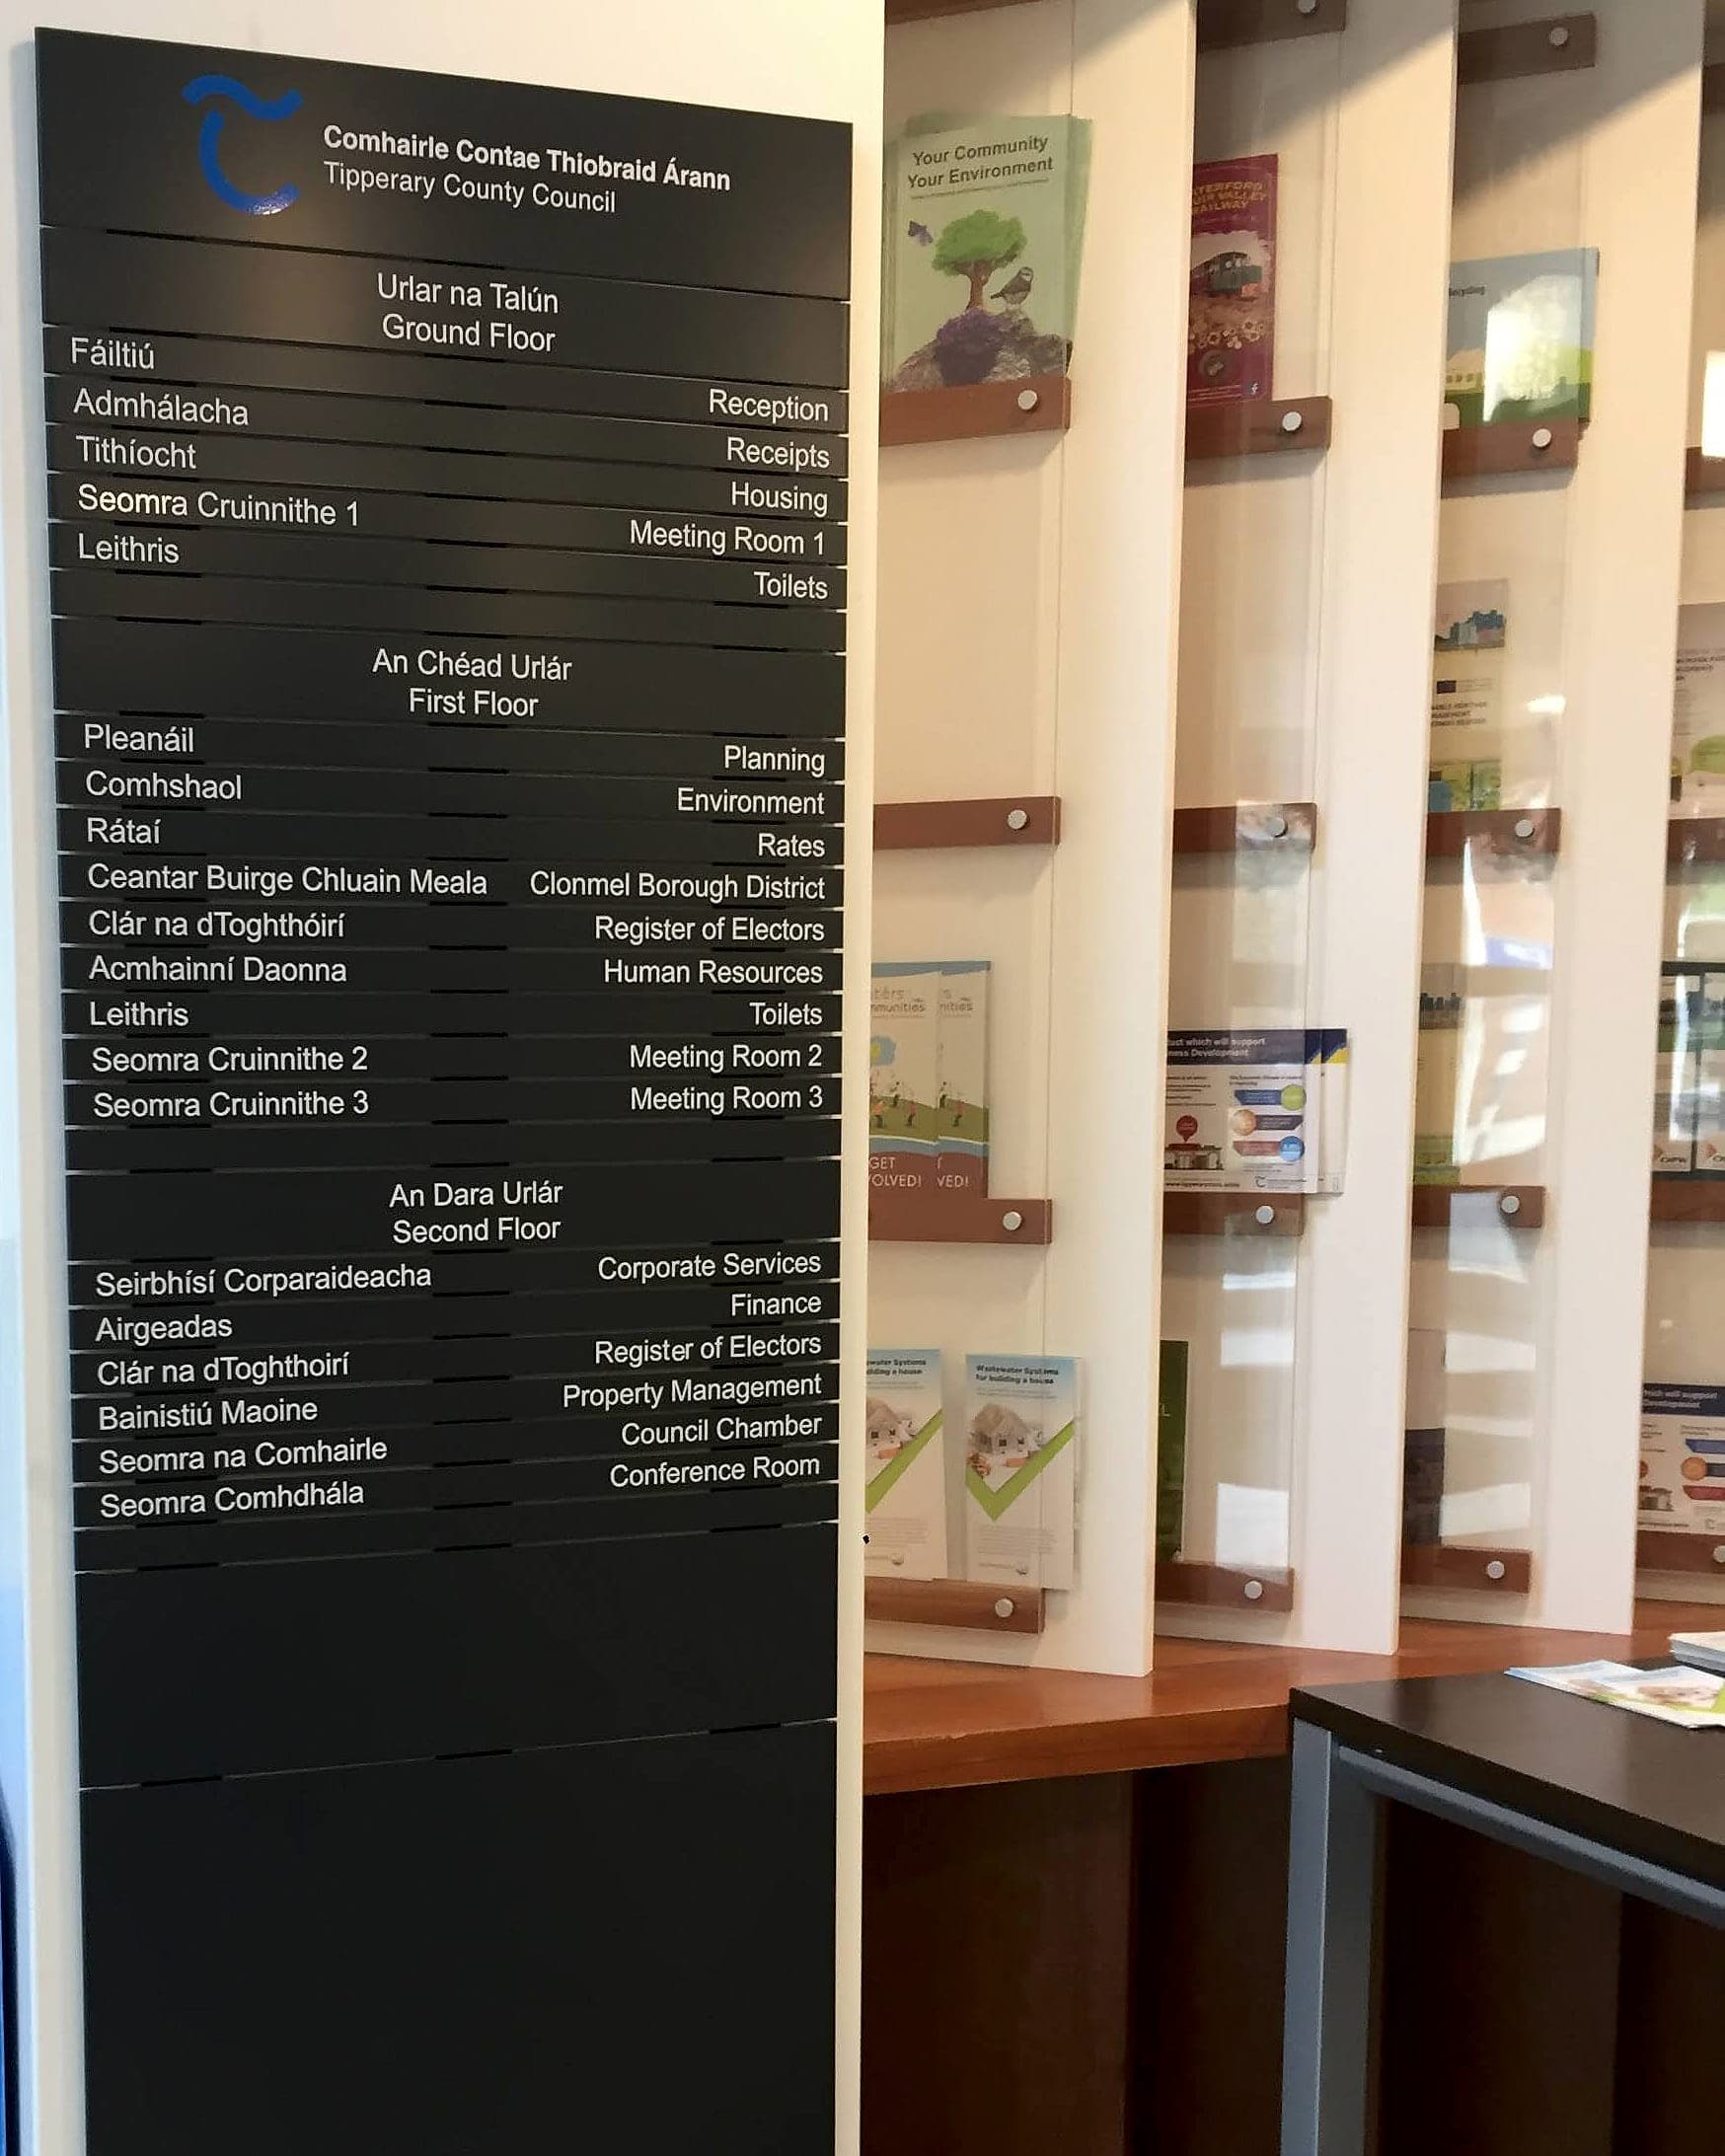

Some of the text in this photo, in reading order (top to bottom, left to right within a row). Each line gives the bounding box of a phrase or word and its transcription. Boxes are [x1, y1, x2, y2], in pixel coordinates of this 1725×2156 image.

[324, 124, 731, 191] Comhairle Contae Thiobraid Árann
[912, 136, 1048, 167] Your Community
[323, 160, 616, 213] Tipperary County Council
[907, 174, 944, 188] Your
[948, 156, 1054, 185] Environment
[377, 271, 559, 314] Urlar na Talún
[382, 313, 557, 352] Ground Floor
[71, 336, 155, 370] Fáiltiú
[72, 387, 249, 426] Admhálacha
[709, 388, 829, 425] Reception
[75, 434, 197, 470] Tithíocht
[726, 435, 830, 473] Receipts
[78, 483, 357, 527] Seomra Cruinnithe 1
[731, 481, 828, 518] Housing
[78, 532, 180, 564] Leithris
[630, 519, 823, 557] Meeting Room 1
[753, 570, 829, 600] Toilets
[371, 647, 573, 681] An Chéad Urlár
[410, 687, 540, 717] First Floor
[84, 722, 194, 753] Pleanáil
[724, 744, 826, 779] Planning
[85, 770, 242, 800] Comhshaol
[677, 786, 825, 815] Environment
[87, 816, 162, 845] Rátaí
[758, 832, 826, 857] Rates
[87, 862, 488, 898] Ceantar Buirge Chluain Meala
[530, 869, 826, 905] Clonmel Borough District
[88, 909, 345, 943] Clár na dToghthóirí
[595, 915, 825, 946] Register of Electors
[88, 954, 347, 983] Acmhainní Daonna
[604, 958, 824, 984] Human Resources
[89, 1000, 189, 1027] Leithris
[748, 1002, 823, 1026] Toilets
[91, 1045, 368, 1073] Seomra Cruinnithe 2
[630, 1043, 823, 1075] Meeting Room 2
[1190, 1048, 1249, 1059] Development
[1231, 1037, 1266, 1050] support
[93, 1089, 369, 1118] Seomra Cruinnithe 3
[631, 1084, 823, 1116] Meeting Room 3
[869, 1156, 896, 1169] GET
[388, 1179, 564, 1209] An Dara Urlár
[392, 1216, 562, 1244] Second Floor
[95, 1262, 432, 1298] Seirbhísí Corparaideacha
[598, 1250, 822, 1285] Corporate Services
[731, 1293, 822, 1317] Finance
[94, 1313, 233, 1347] Airgeadas
[595, 1333, 822, 1369] Register of Electors
[97, 1351, 350, 1386] Clár na dToghthoirí
[563, 1373, 823, 1412] Property Management
[99, 1397, 319, 1431] Bainistiú Maoine
[621, 1413, 823, 1447] Council Chamber
[99, 1436, 388, 1474] Seomra na Comhairle
[609, 1455, 821, 1488] Conference Room
[100, 1480, 365, 1519] Seomra Comhdhála
